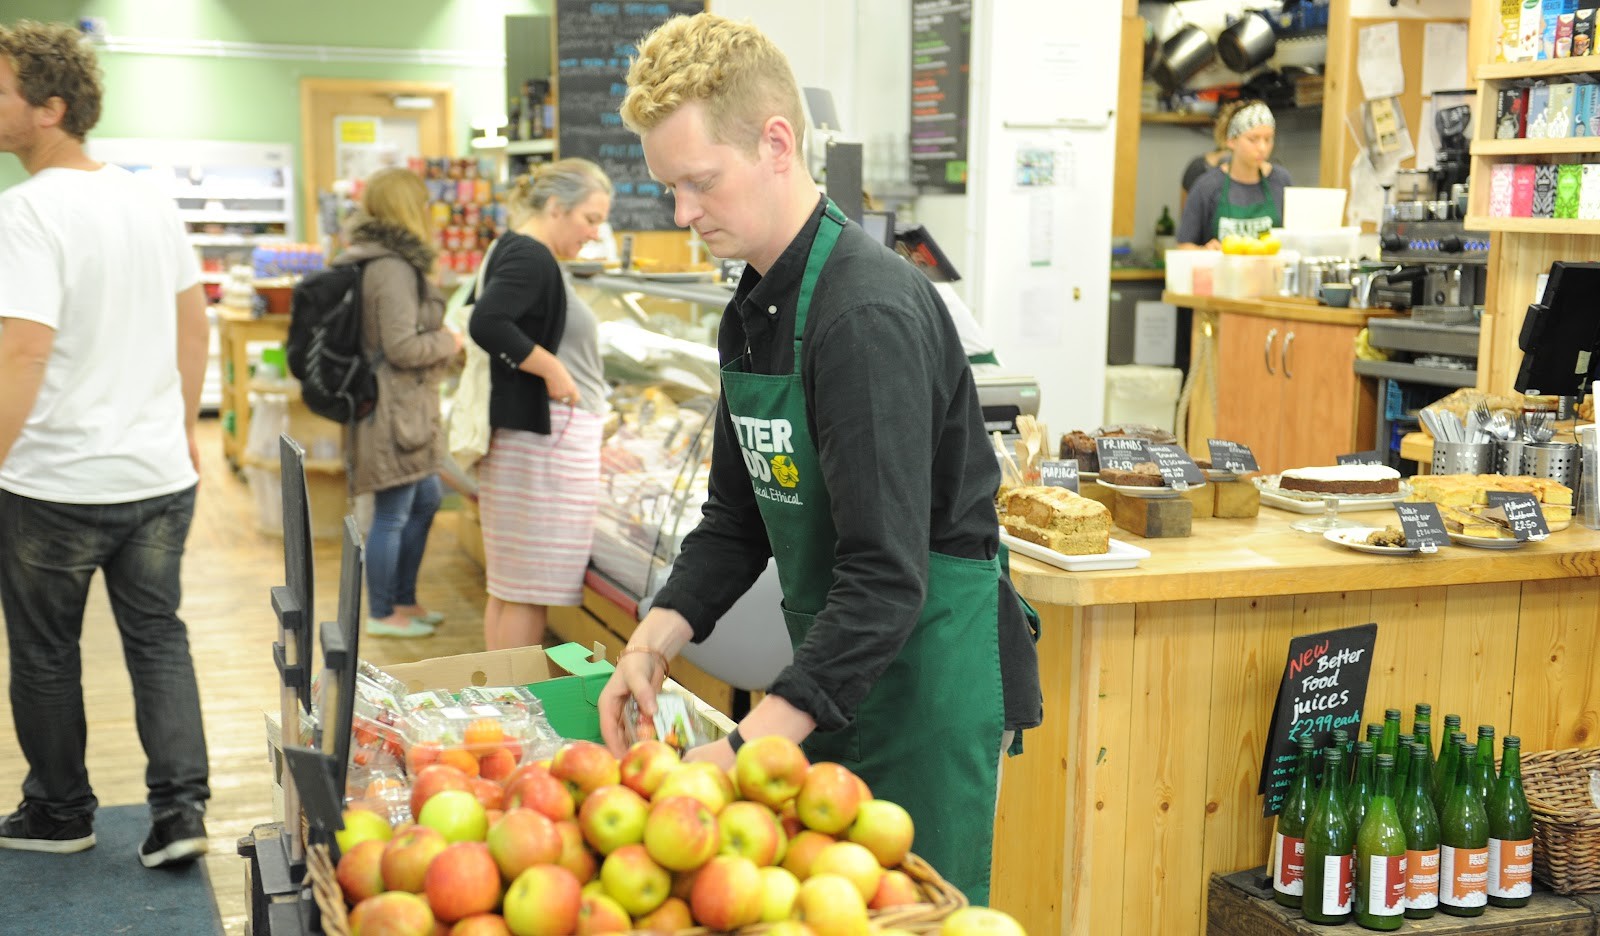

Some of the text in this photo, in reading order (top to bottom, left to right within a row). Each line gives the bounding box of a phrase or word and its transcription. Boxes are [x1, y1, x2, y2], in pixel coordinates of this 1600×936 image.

[1316, 647, 1366, 674] Better
[1301, 668, 1341, 694] Food
[1290, 689, 1350, 726] juices
[1333, 709, 1361, 729] each
